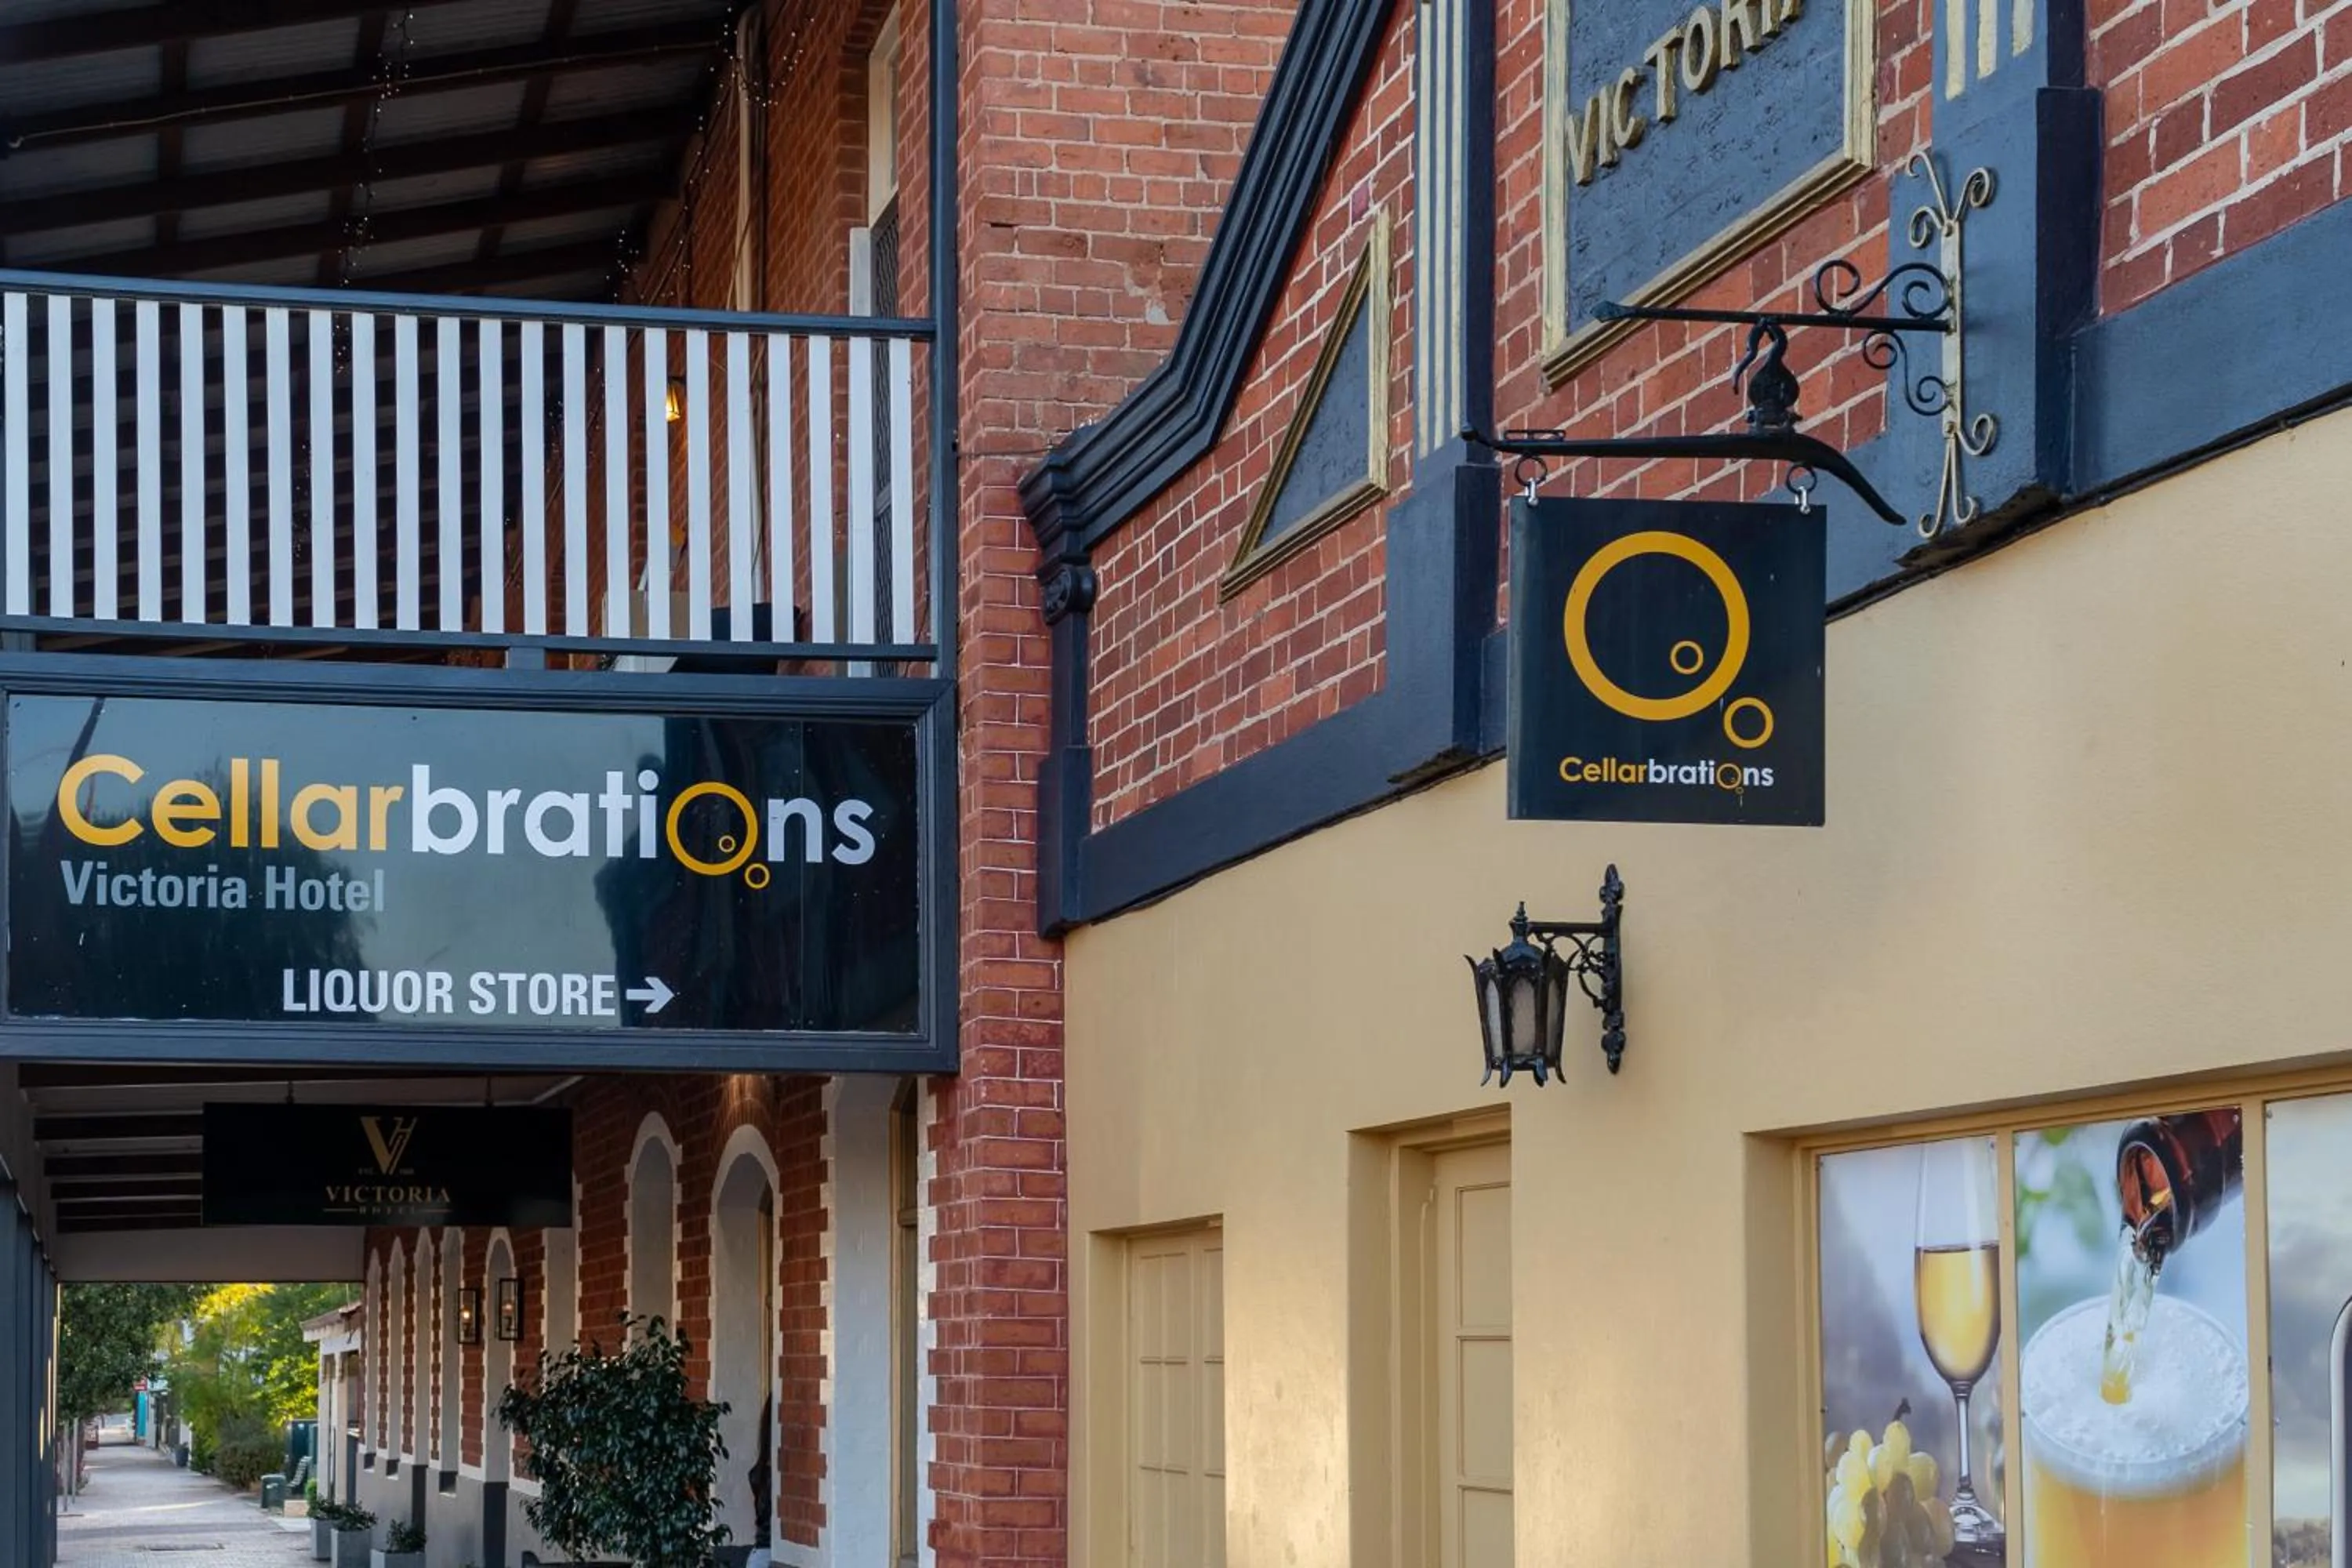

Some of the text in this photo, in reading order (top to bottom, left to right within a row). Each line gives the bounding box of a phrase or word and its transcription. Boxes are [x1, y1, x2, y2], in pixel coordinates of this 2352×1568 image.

[1567, 0, 1799, 185] VICTOR
[60, 859, 385, 913] Victoria Hotel
[282, 967, 616, 1016] LIQUOR STORE
[325, 1185, 452, 1203] VICTORIA
